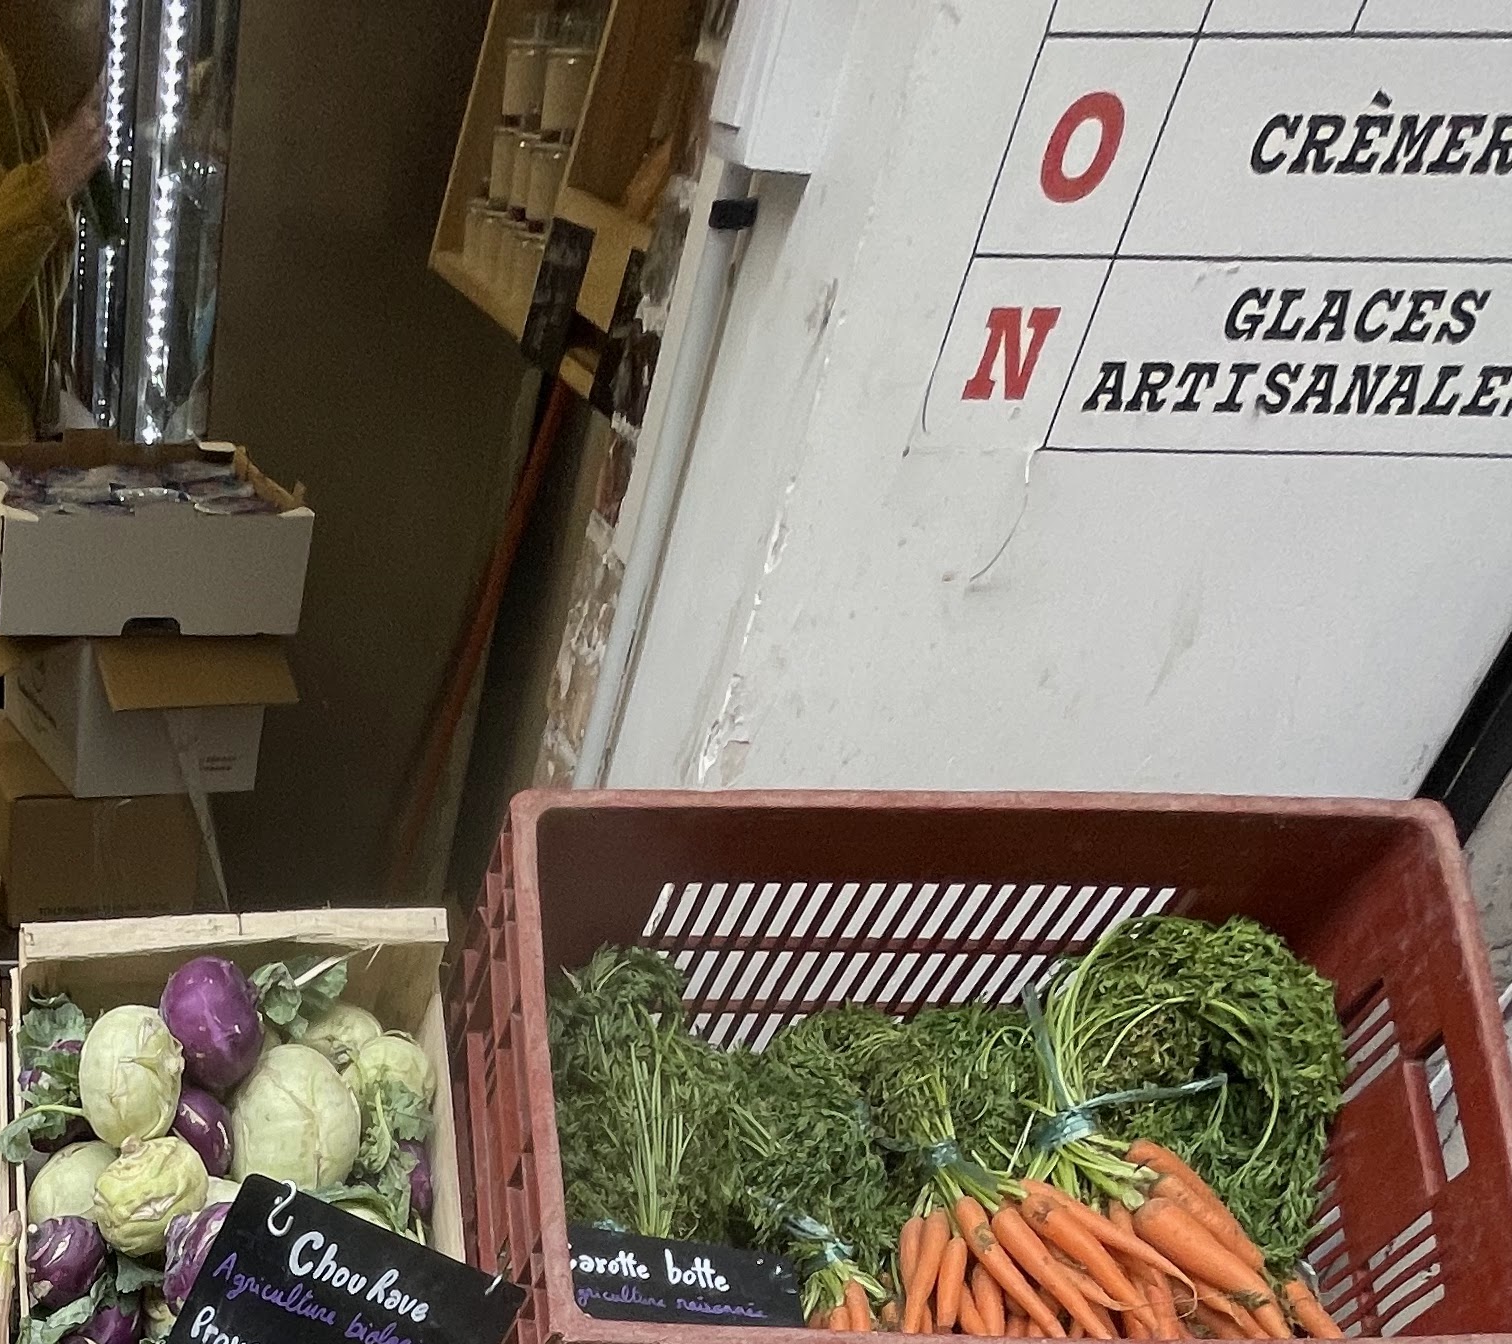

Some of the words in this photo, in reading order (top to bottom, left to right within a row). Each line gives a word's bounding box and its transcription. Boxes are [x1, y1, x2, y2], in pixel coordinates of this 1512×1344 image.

[1040, 91, 1125, 203] O
[1224, 288, 1492, 344] GLACES
[961, 306, 1061, 401] N
[212, 1252, 336, 1326] Agriculture
[289, 1231, 367, 1296] Chou
[664, 1249, 730, 1292] botte
